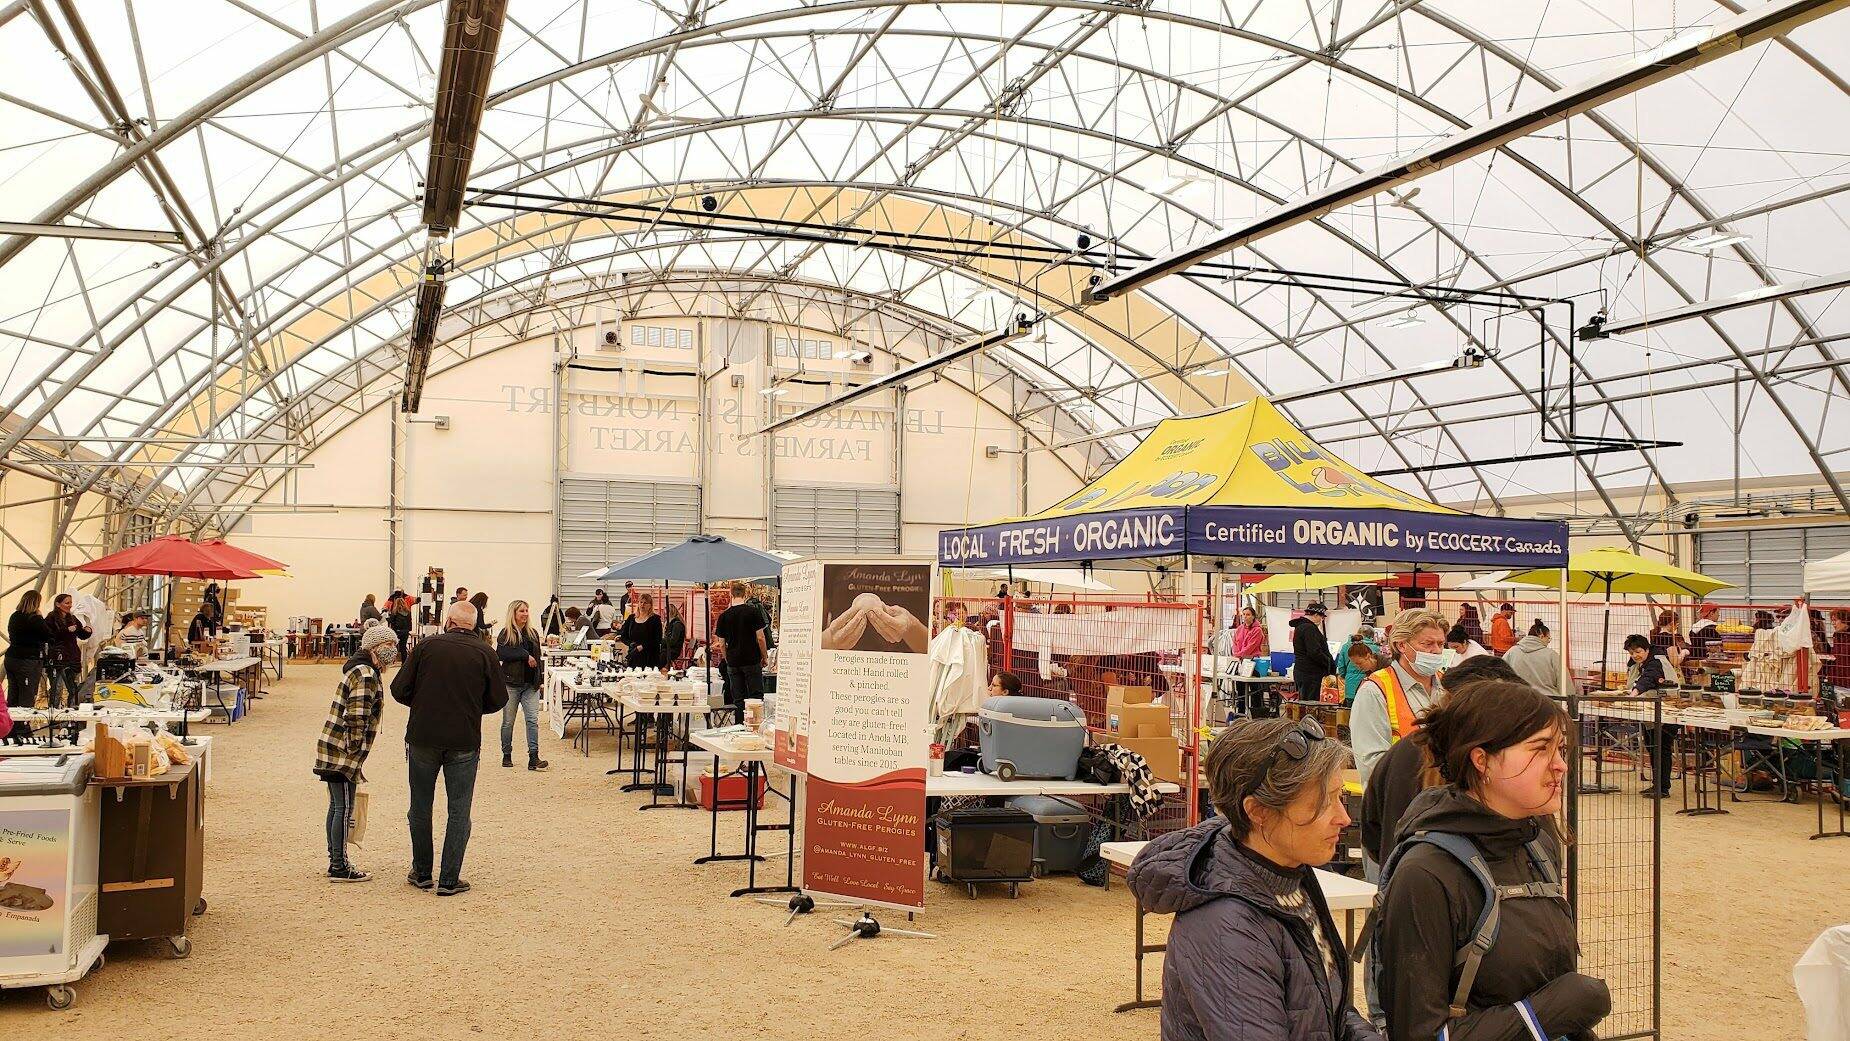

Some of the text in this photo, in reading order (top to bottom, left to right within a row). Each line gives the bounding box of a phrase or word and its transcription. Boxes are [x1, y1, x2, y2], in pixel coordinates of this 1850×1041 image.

[944, 514, 1174, 560] LOCAL FRESH ORGANIC
[1205, 519, 1562, 554] Certified ORGANIC by ECOCERT Canada
[845, 567, 891, 582] Amanda
[834, 653, 909, 666] Perogies made from
[832, 667, 909, 679] scratch! Hand rolled
[830, 690, 852, 701] These
[853, 693, 886, 705] perogies
[834, 705, 853, 715] good
[854, 707, 869, 716] you
[891, 708, 903, 718] tell
[831, 716, 847, 728] they
[828, 729, 857, 740] Located
[858, 732, 867, 741] in
[868, 732, 891, 743] Anola
[832, 743, 903, 757] serving Manitoban
[834, 756, 856, 766] tables
[857, 757, 879, 768] since
[817, 799, 919, 827] Amanda Lynn
[2, 828, 57, 843] Pre-Fried Foods
[7, 838, 27, 846] Serve
